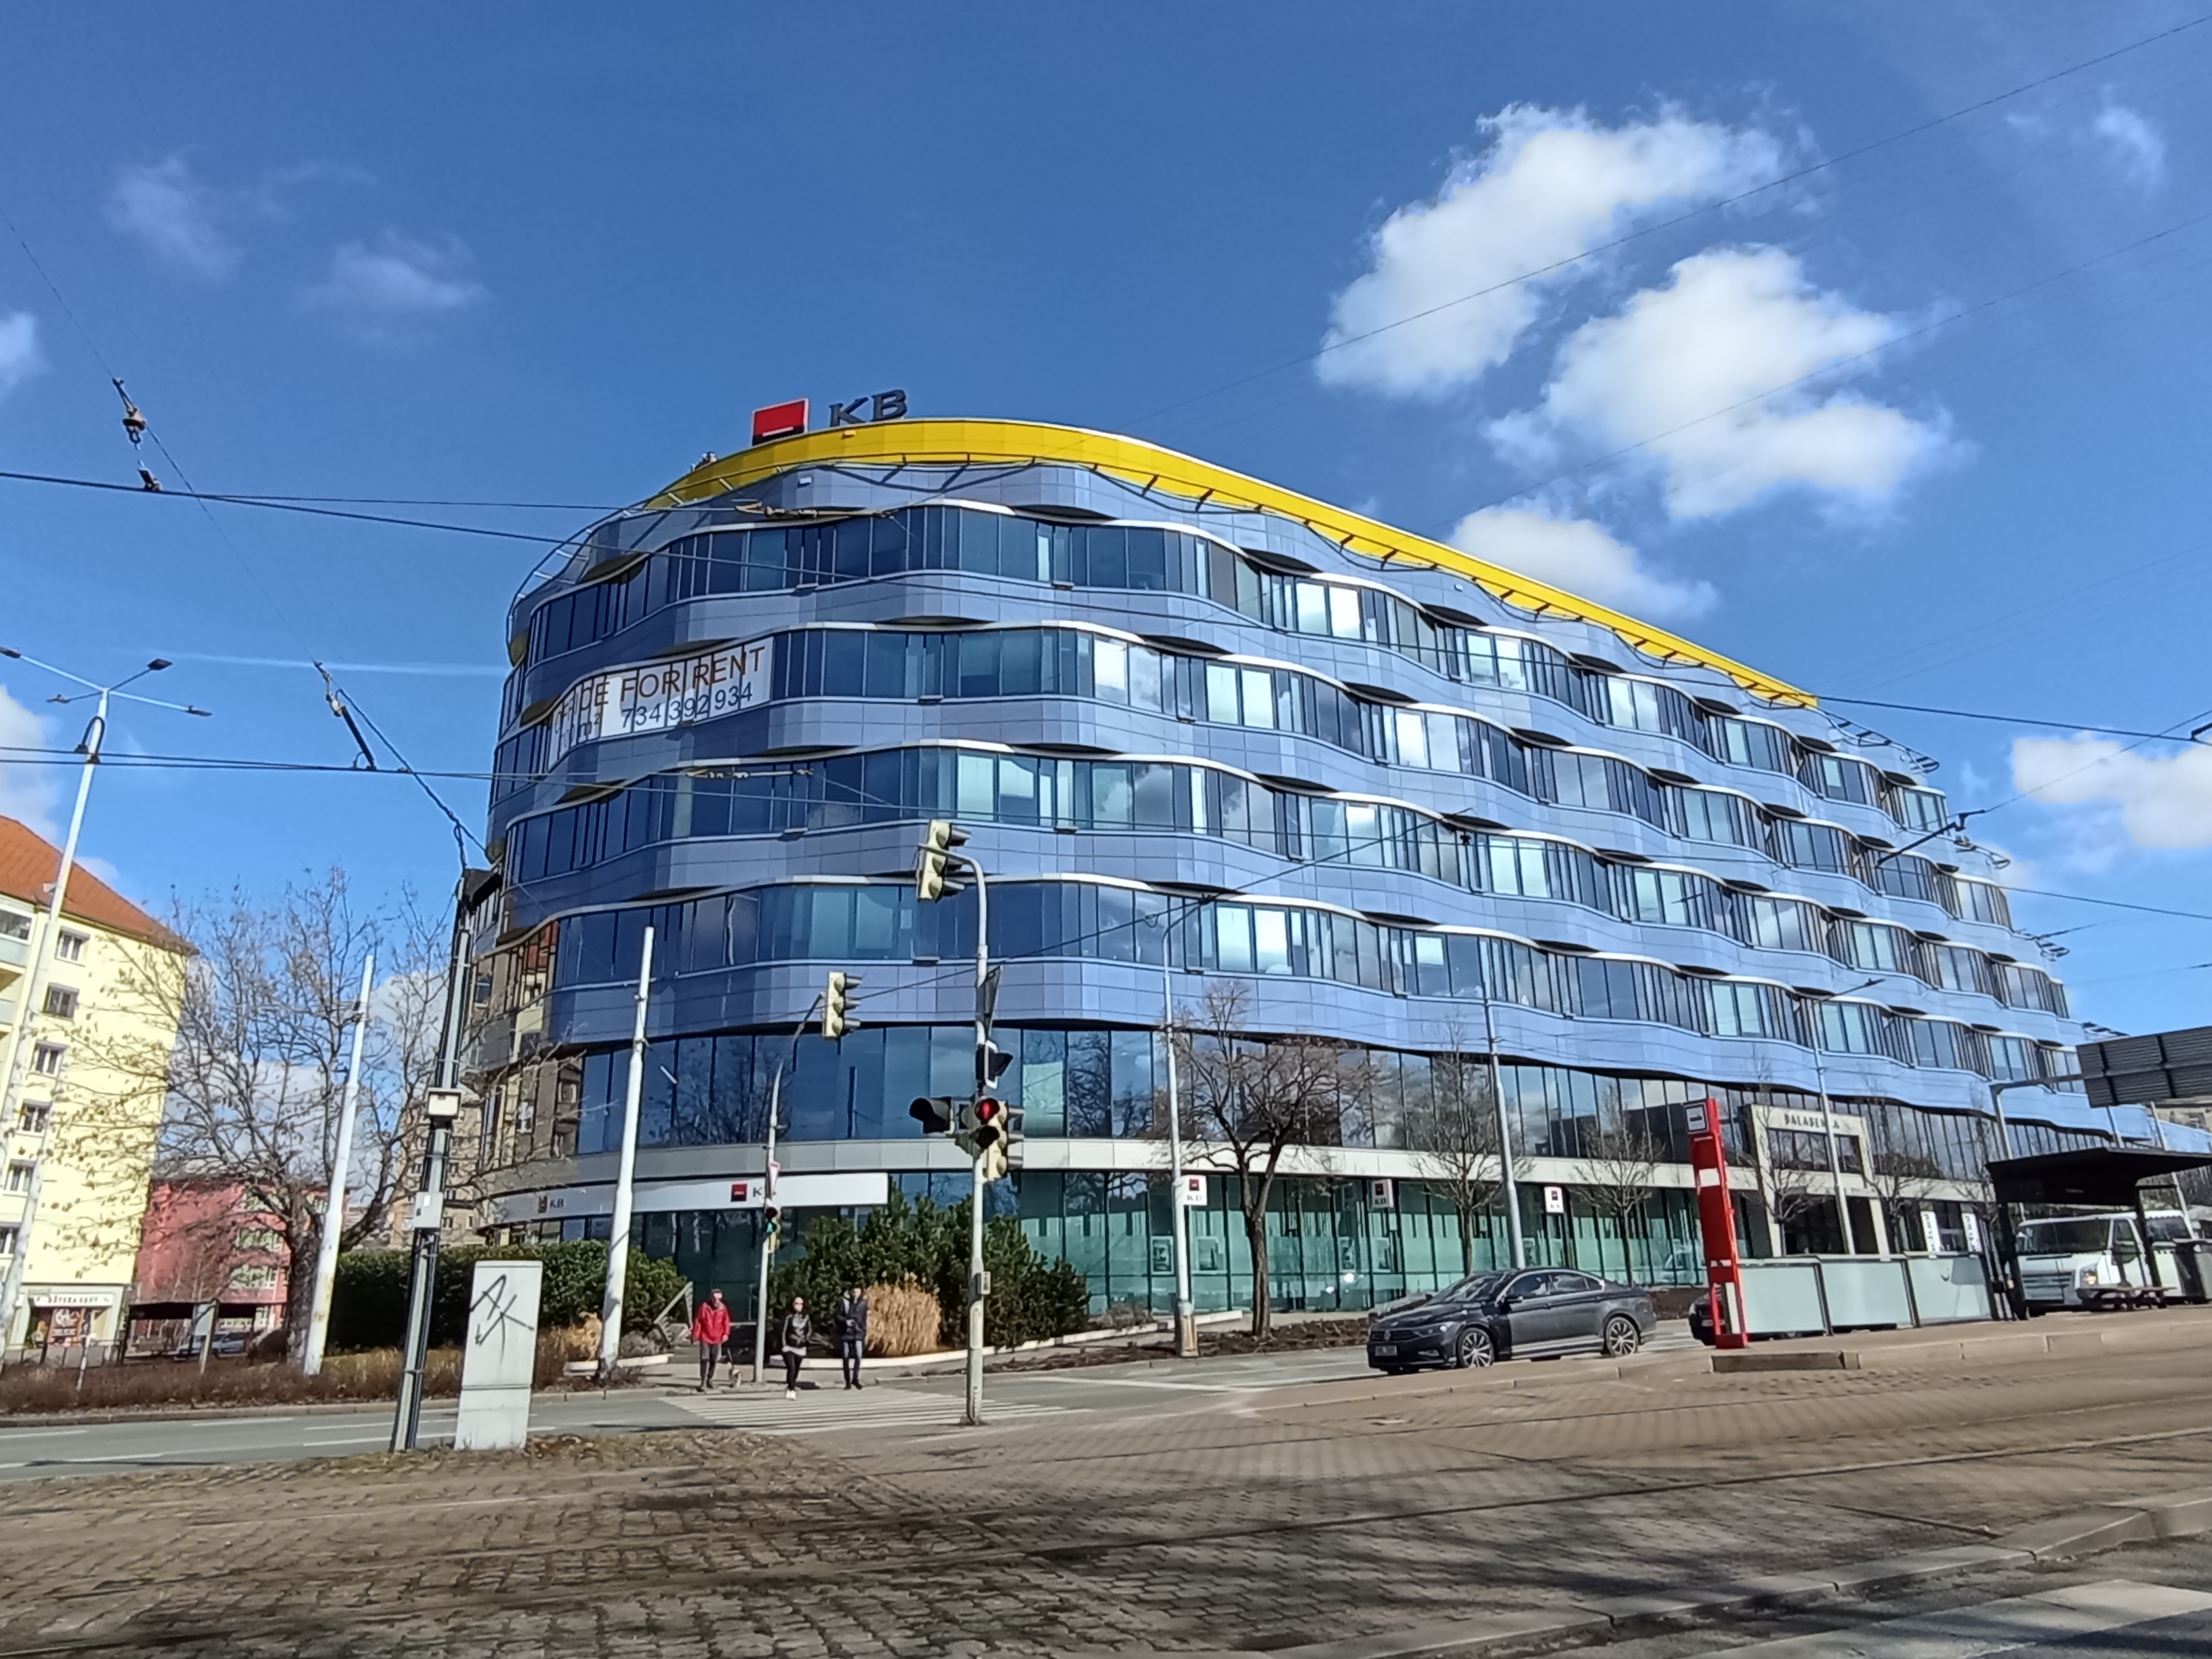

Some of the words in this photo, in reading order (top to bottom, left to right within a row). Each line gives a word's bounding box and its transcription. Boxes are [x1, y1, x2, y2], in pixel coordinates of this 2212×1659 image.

[829, 389, 907, 427] KB
[621, 671, 680, 702] FOR
[693, 647, 765, 689] RENT
[622, 703, 661, 728] 734
[669, 695, 710, 720] 392
[715, 681, 753, 710] 934
[1784, 1113, 1840, 1129] BALABENA
